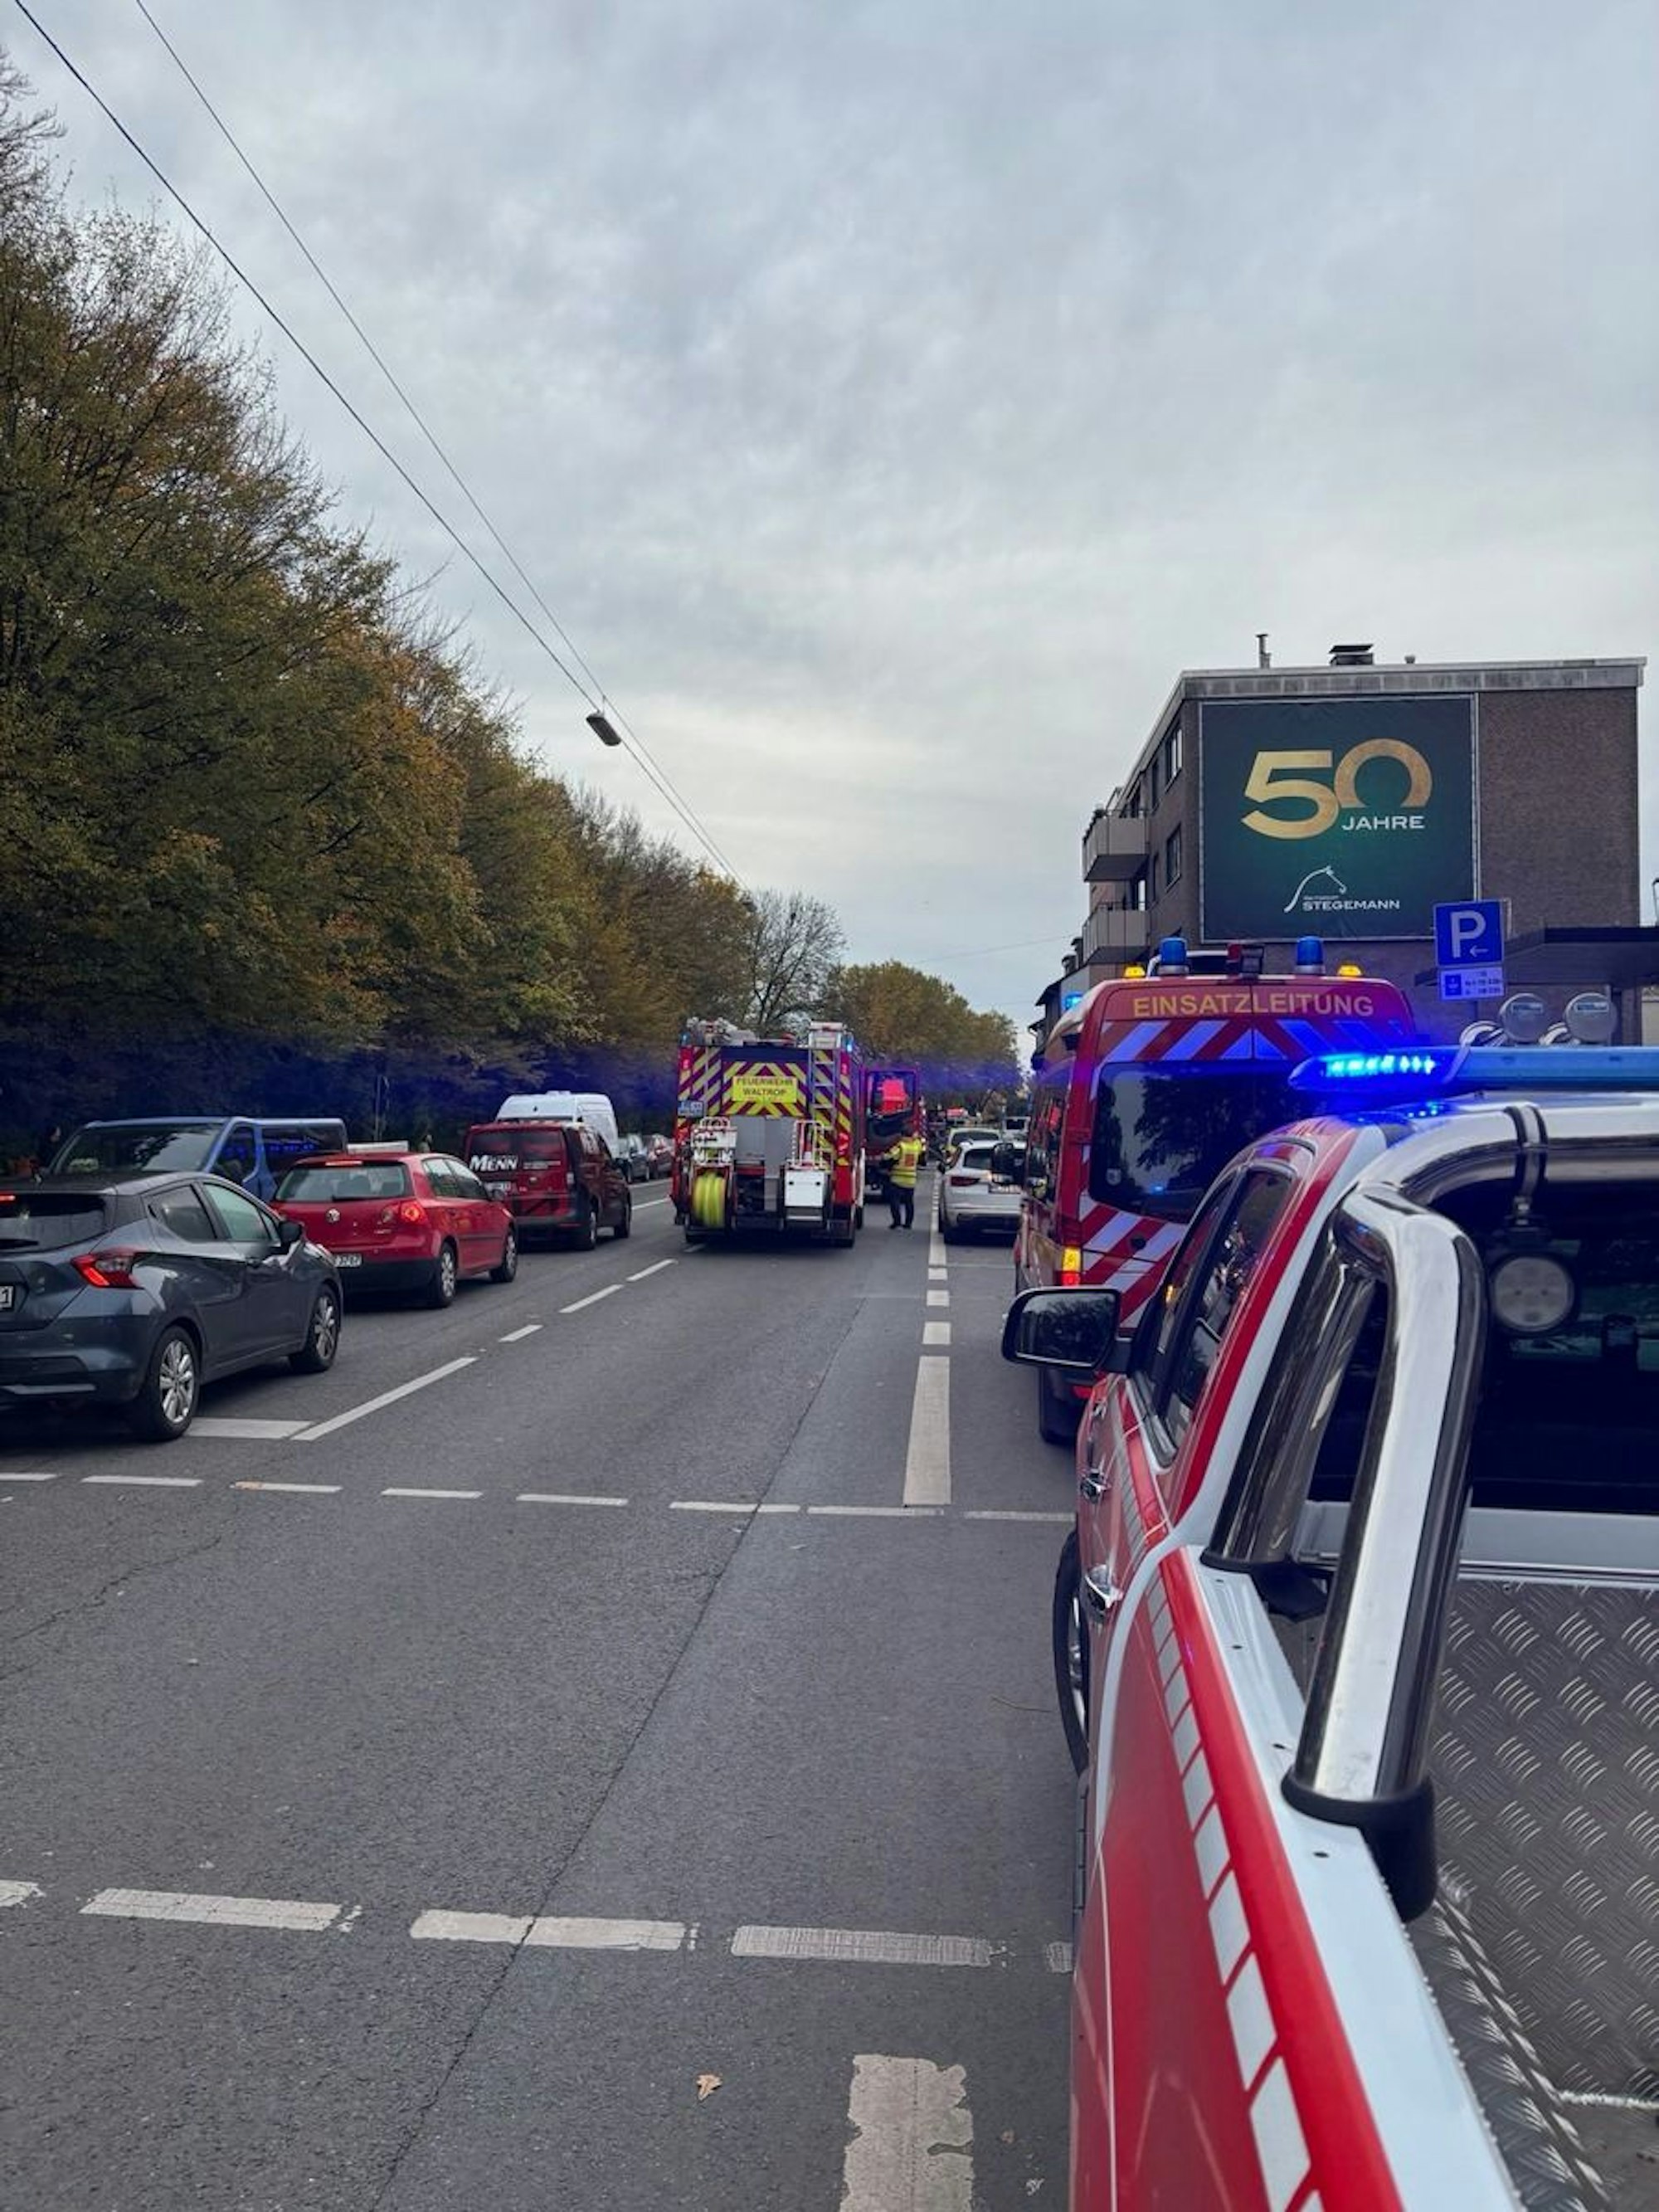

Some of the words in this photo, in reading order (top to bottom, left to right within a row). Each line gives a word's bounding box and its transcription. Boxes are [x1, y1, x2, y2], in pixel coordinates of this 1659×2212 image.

[1241, 738, 1433, 840] 50
[1341, 815, 1426, 831] JAHRE
[1301, 899, 1400, 912] STEGEMANN
[1451, 910, 1486, 959] P
[1133, 993, 1374, 1018] EINSATZLEITUNG
[469, 1154, 519, 1172] MENN
